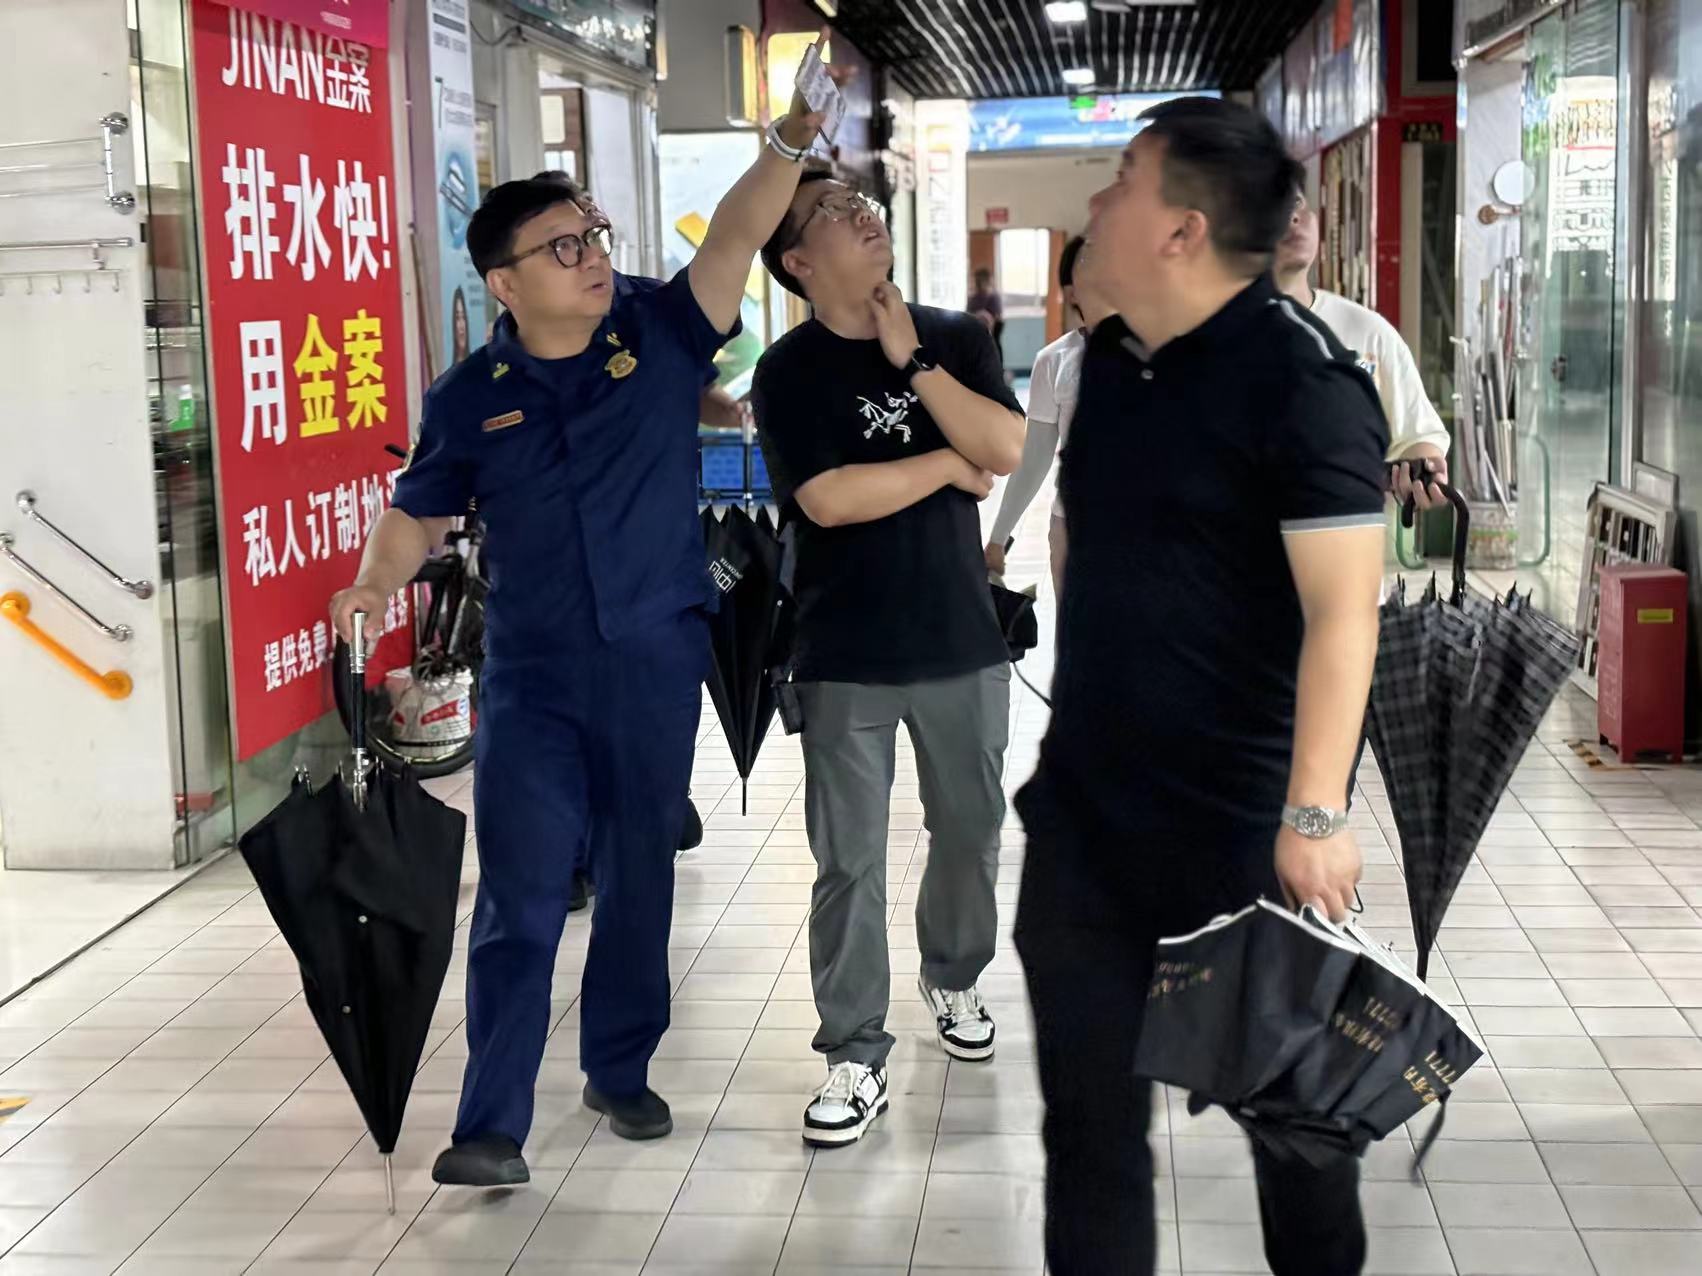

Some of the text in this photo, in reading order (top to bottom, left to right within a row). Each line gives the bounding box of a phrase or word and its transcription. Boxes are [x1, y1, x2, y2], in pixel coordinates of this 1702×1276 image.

[222, 142, 392, 282] 排水快!
[239, 308, 389, 452] 用金案
